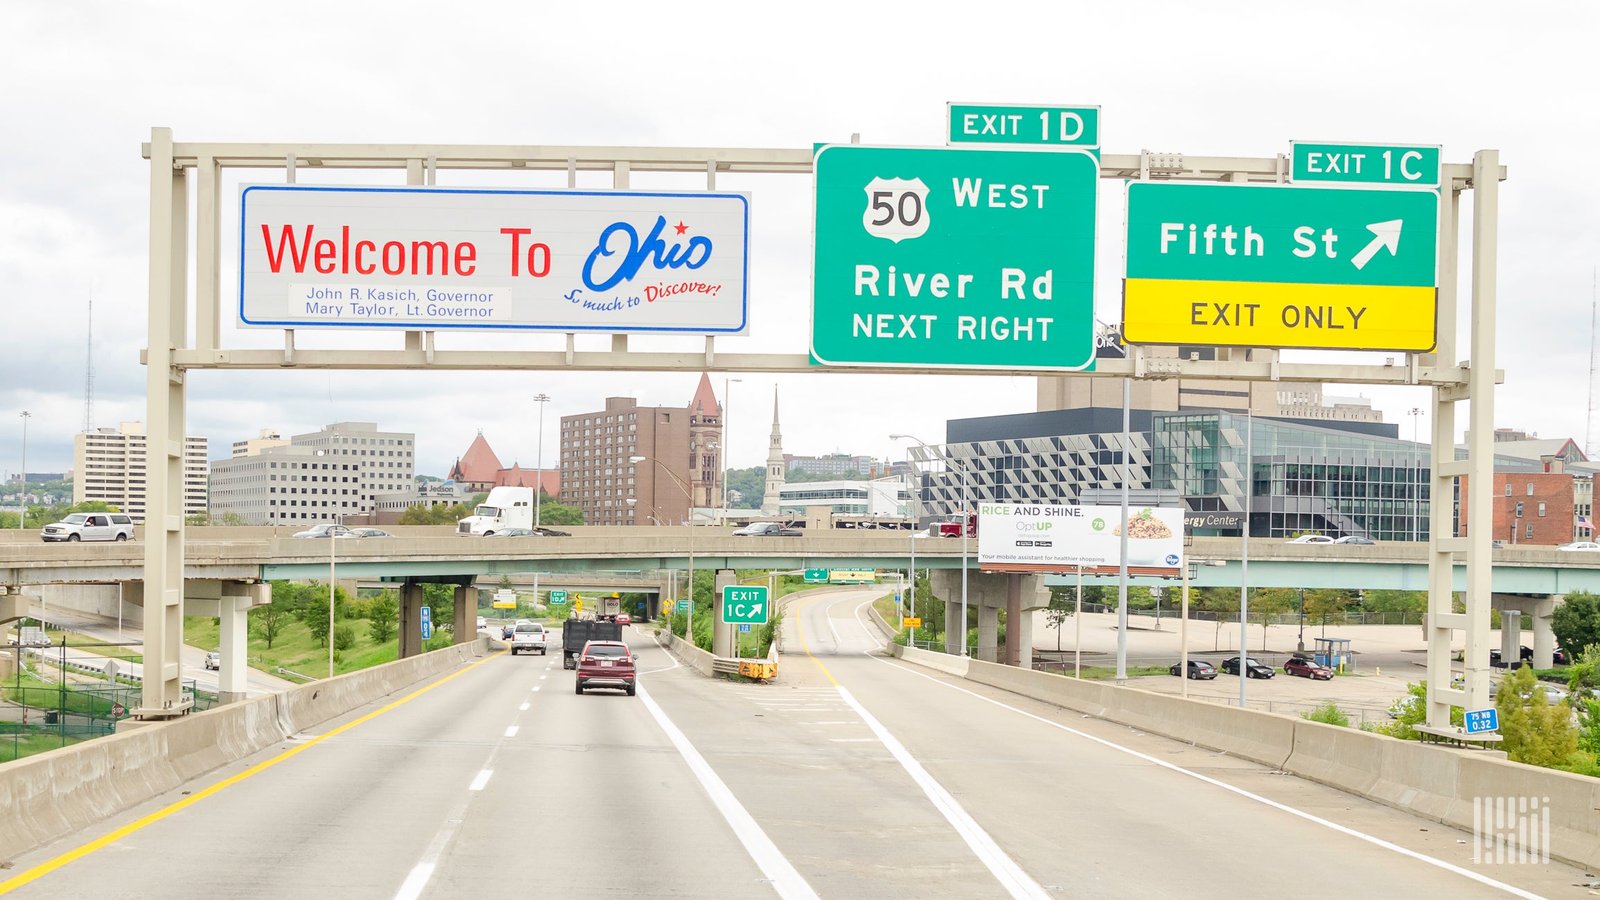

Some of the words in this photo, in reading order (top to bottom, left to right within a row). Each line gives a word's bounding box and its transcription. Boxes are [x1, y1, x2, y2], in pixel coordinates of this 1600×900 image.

[963, 114, 1022, 136] EXIT
[1039, 111, 1084, 141] 1D
[1307, 152, 1366, 174] EXIT
[1382, 150, 1423, 180] 1C
[952, 177, 1050, 209] WEST
[871, 191, 922, 227] 50
[261, 223, 477, 277] Welcome
[500, 227, 551, 278] To
[581, 215, 713, 292] Ohio
[1160, 222, 1264, 256] Fifth
[1292, 225, 1338, 259] St
[306, 287, 343, 300] John
[350, 288, 362, 300] R.
[367, 288, 420, 303] Kasich,
[426, 289, 494, 302] Governor
[583, 297, 625, 311] much
[627, 296, 640, 308] to
[644, 281, 722, 303] Discover!
[854, 264, 974, 298] River
[1001, 267, 1053, 300] Rd
[306, 302, 343, 317] Mary
[350, 303, 398, 317] Taylor,
[407, 304, 423, 316] Lt.
[426, 304, 494, 317] Governor
[1191, 302, 1260, 327] EXIT
[1281, 304, 1367, 330] ONLY
[852, 313, 938, 339] NEXT
[957, 315, 1054, 341] RIGHT
[982, 506, 1010, 515] RICE
[1014, 507, 1041, 516] AND
[1044, 507, 1084, 517] SHINE.
[1184, 516, 1205, 528] ergy
[727, 603, 745, 617] 1C
[731, 591, 759, 601] EXIT
[1472, 720, 1491, 730] 0.32
